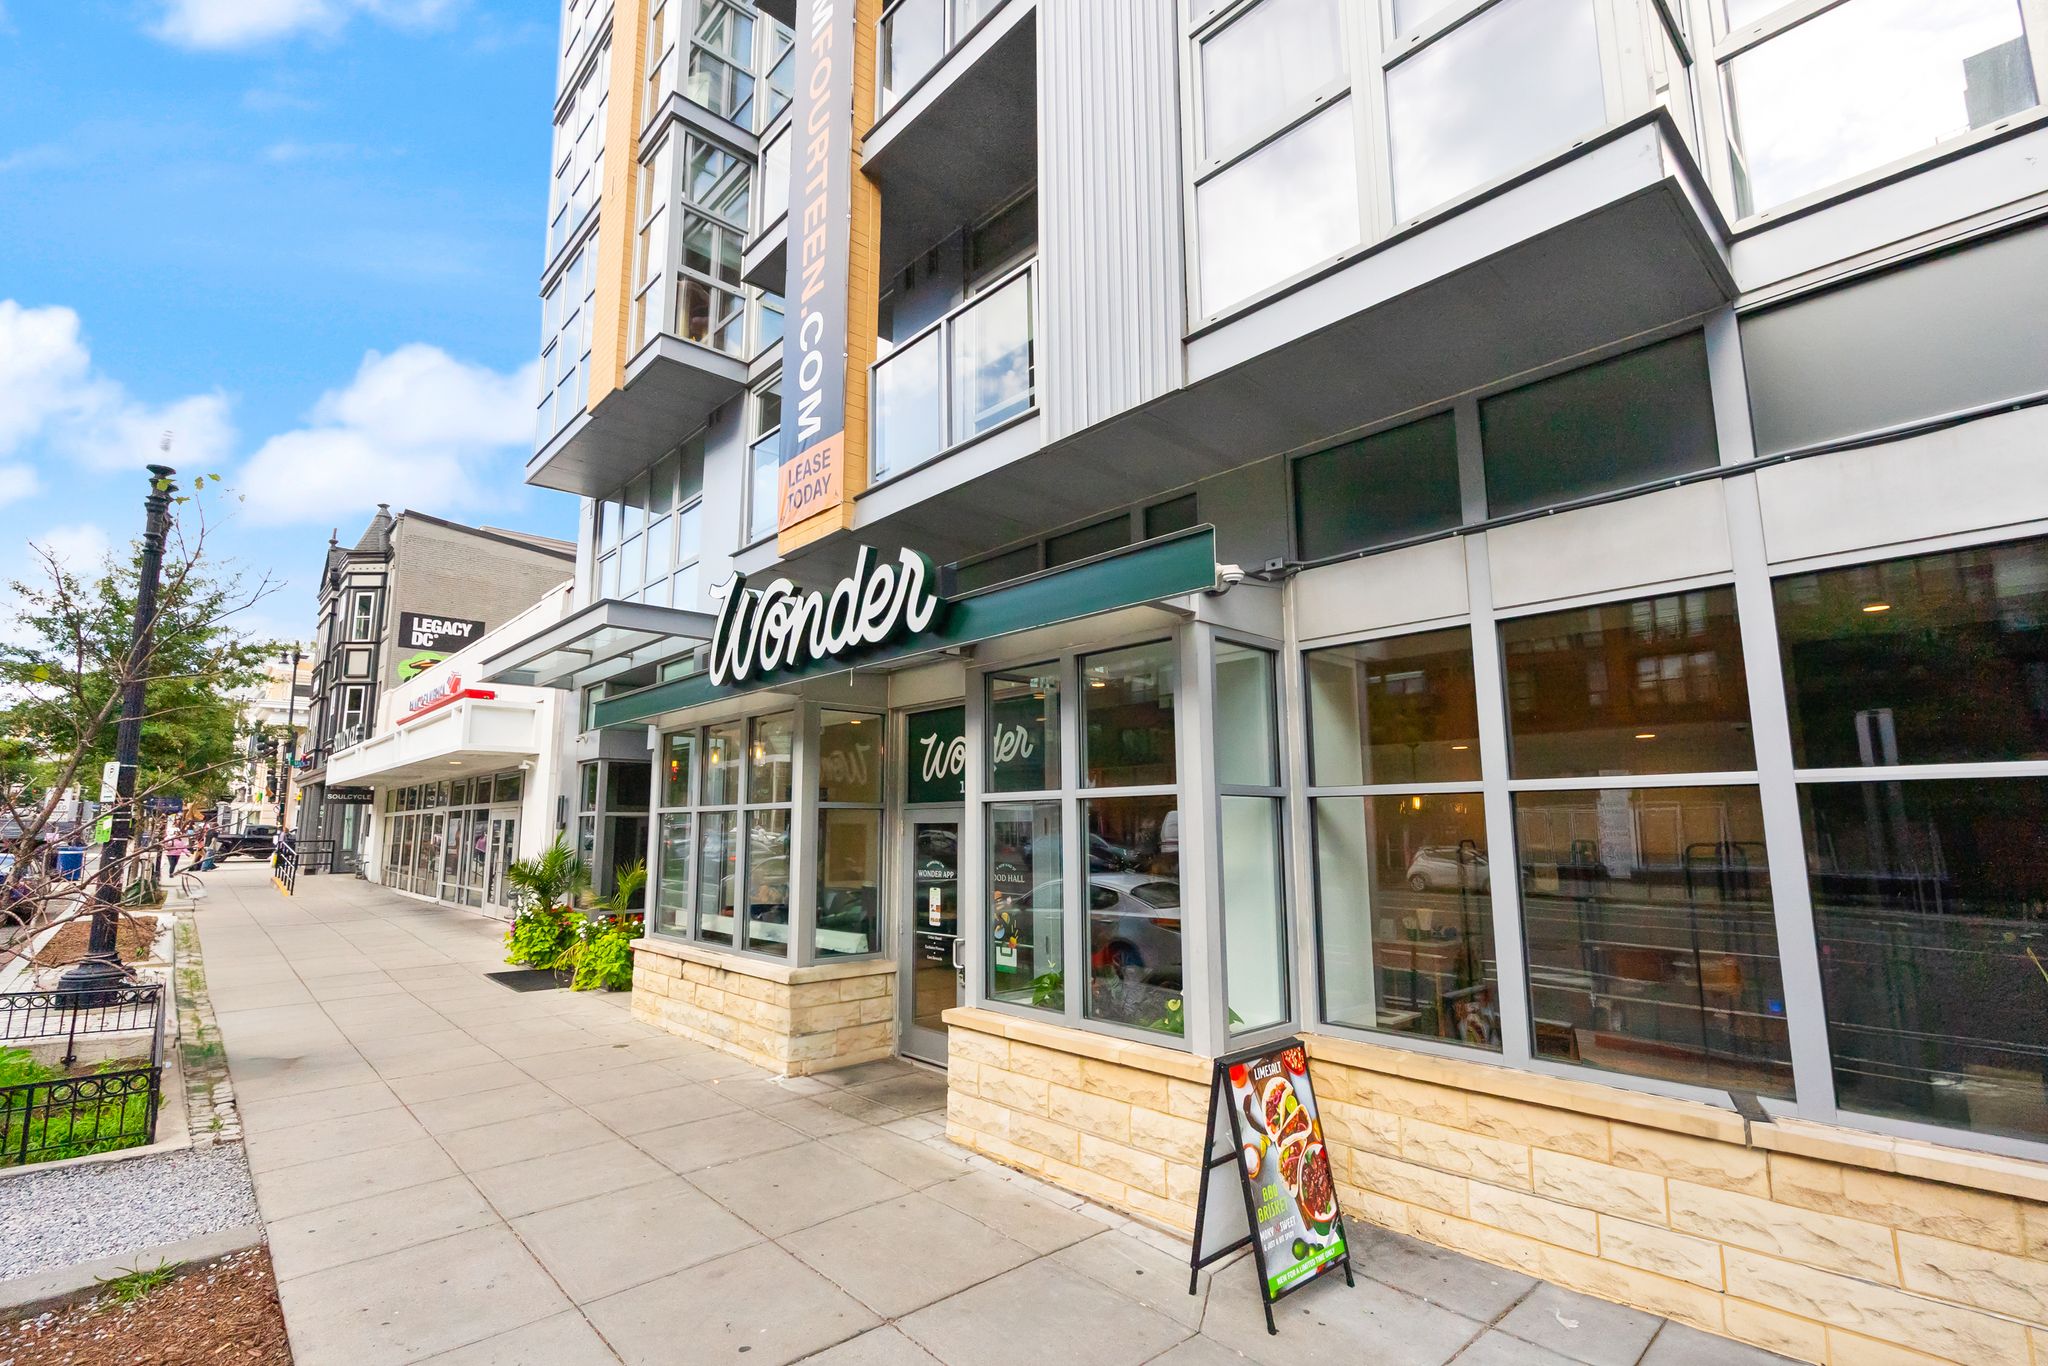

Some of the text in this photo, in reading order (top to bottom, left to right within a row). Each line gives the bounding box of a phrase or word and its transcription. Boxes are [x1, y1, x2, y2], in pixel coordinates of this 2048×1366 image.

[788, 448, 831, 488] LEASE
[787, 473, 832, 512] TODAY
[709, 544, 937, 687] Wonder
[412, 617, 472, 637] LEGACY
[918, 870, 942, 878] WONDER
[1008, 874, 1025, 883] HALL
[1254, 1061, 1281, 1080] LIMESALT
[1262, 1184, 1278, 1202] BBQ
[1258, 1197, 1289, 1223] BRISKET
[1280, 1216, 1296, 1232] SWEET
